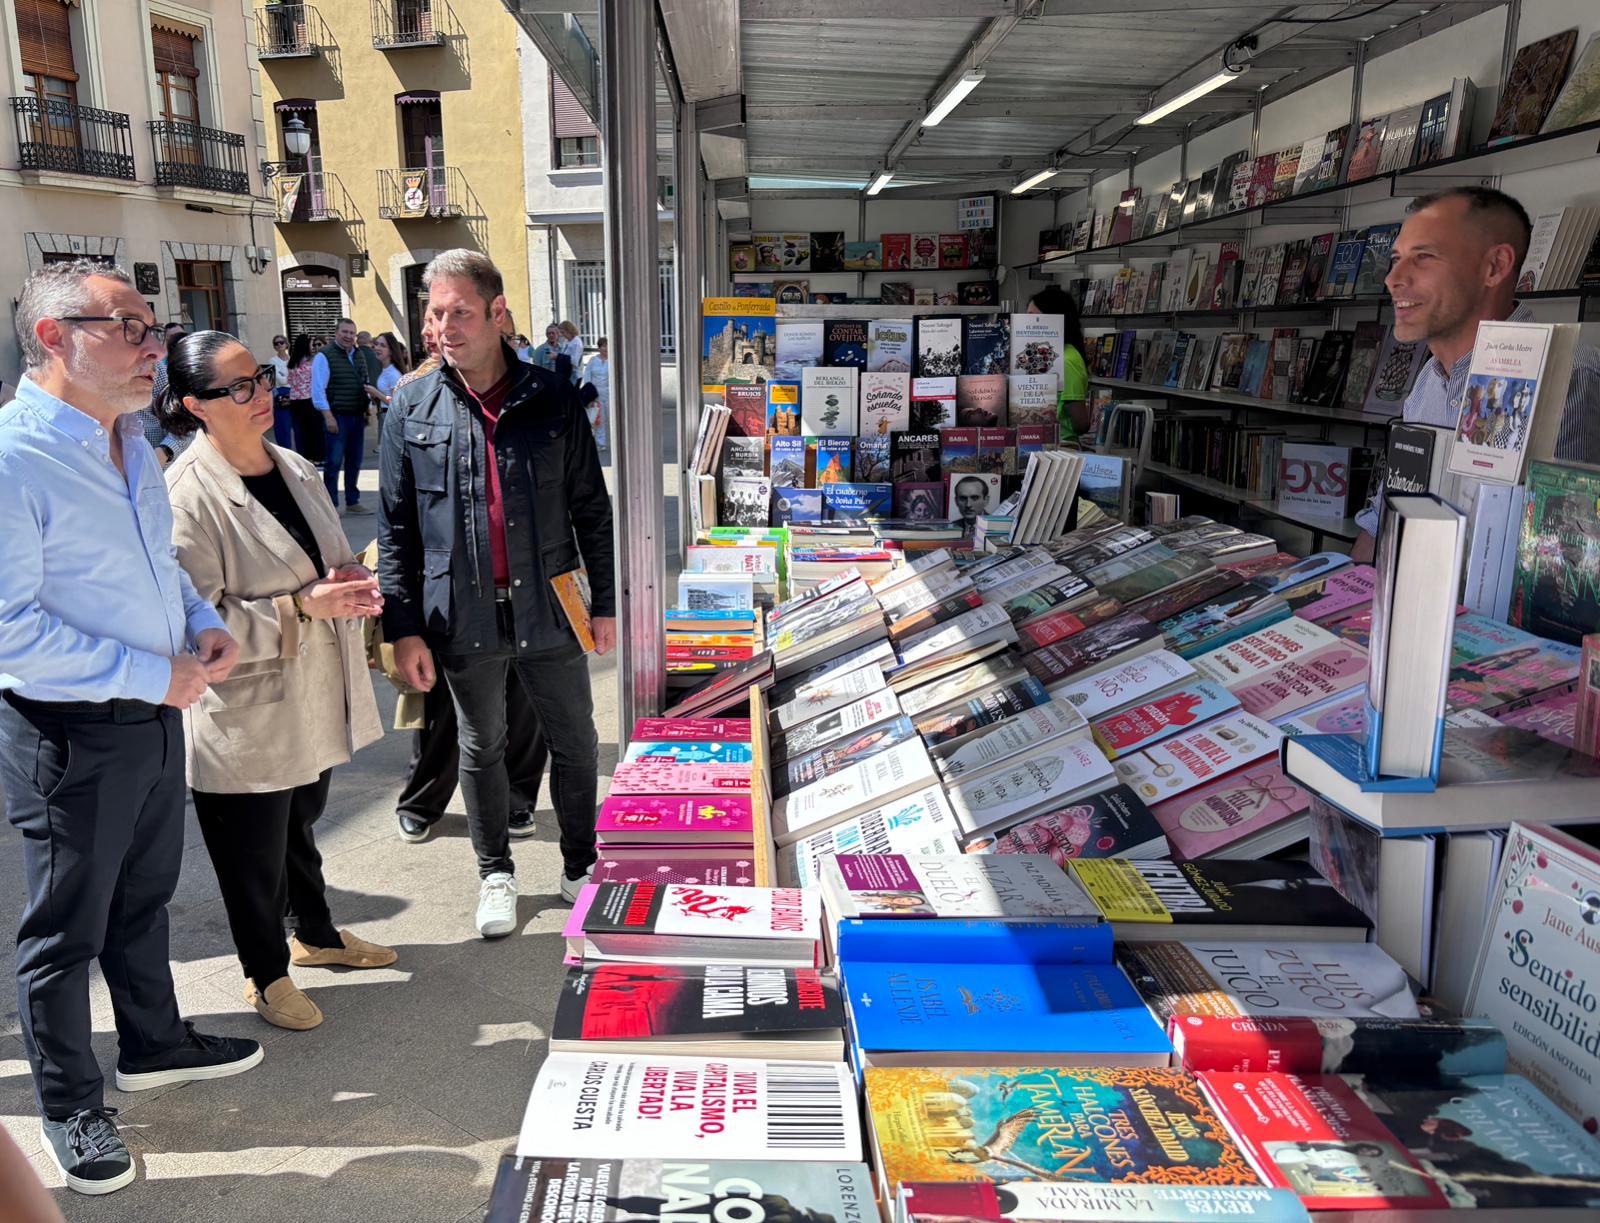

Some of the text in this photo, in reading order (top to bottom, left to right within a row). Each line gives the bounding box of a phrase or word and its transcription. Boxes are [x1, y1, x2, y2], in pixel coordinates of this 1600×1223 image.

[709, 301, 771, 313] Castillo Ponferrada
[829, 334, 867, 342] OVEJITAS
[832, 328, 863, 336] CONTAR
[866, 390, 903, 403] Soñando
[1017, 383, 1049, 391] VIENTRE
[867, 399, 902, 413] escuelas
[860, 441, 887, 449] Omaña
[898, 434, 939, 443] ANCARES
[826, 486, 868, 496] El cuaderno
[854, 496, 872, 505] Pilar
[1243, 638, 1288, 663] ESTE LIBRO
[1268, 632, 1304, 654] COMES
[1236, 650, 1259, 664] PARA
[1272, 669, 1313, 697] PARA TODA
[1281, 661, 1337, 694] QUE CUENTAN
[1268, 685, 1291, 700] VIDA
[1115, 718, 1133, 735] que
[1143, 703, 1172, 725] corazón
[1134, 718, 1156, 739] algo
[972, 788, 988, 804] REAL
[1225, 789, 1256, 811] FELIZ
[1202, 794, 1244, 827] MENOPAUSIA
[1045, 814, 1076, 857] Tu cuerpo
[919, 860, 965, 906] DUELO
[976, 860, 1025, 904] ALZAR
[1021, 860, 1064, 903] PAZ PADILLA
[1183, 861, 1233, 910] GÓMEZ-JURADO
[1209, 878, 1233, 898] JUAN
[771, 888, 802, 906] PEDRO
[771, 907, 808, 931] BAÑOS
[1543, 907, 1573, 937] Jane
[1194, 944, 1280, 1008] JUICIO
[1259, 975, 1284, 988] EL
[1264, 948, 1346, 1011] ZUECO
[1312, 961, 1371, 1004] LUIS
[1508, 928, 1597, 1014] Sentido
[702, 986, 745, 1019] CAMA
[885, 970, 923, 1025] ALLENDE
[914, 977, 948, 1019] ISABEL
[1232, 1021, 1288, 1032] CRIADA
[1513, 1020, 1550, 1055] EDICIÓN
[1550, 1048, 1592, 1085] ANOTADA
[572, 1060, 609, 1131] CARLOS CUESTA
[637, 1065, 670, 1121] LIBERTAD!
[669, 1069, 699, 1112] VIVA LA
[695, 1062, 729, 1139] CAPITALISMO,
[1478, 1086, 1527, 1121] LAS
[732, 1097, 757, 1114] EL
[1069, 1113, 1093, 1139] PARA
[1071, 1085, 1135, 1168] HALCONES
[1108, 1111, 1139, 1139] TRES
[1128, 1088, 1189, 1162] SÁNCHEZ ADALID
[1165, 1110, 1200, 1141] JESÚS
[1449, 1096, 1531, 1163] CRIADA
[524, 1161, 542, 1202] VIDA DESTINO
[558, 1162, 581, 1217] LA FIGURA DE
[578, 1178, 592, 1200] PARA
[595, 1163, 612, 1195] VUELVE
[1043, 1186, 1137, 1199] DEL MAL
[836, 1168, 862, 1223] LORENZ
[1036, 1195, 1154, 1212] LA MIRADA
[1153, 1188, 1272, 1203] MONFORTE
[1188, 1201, 1256, 1216] REYES
